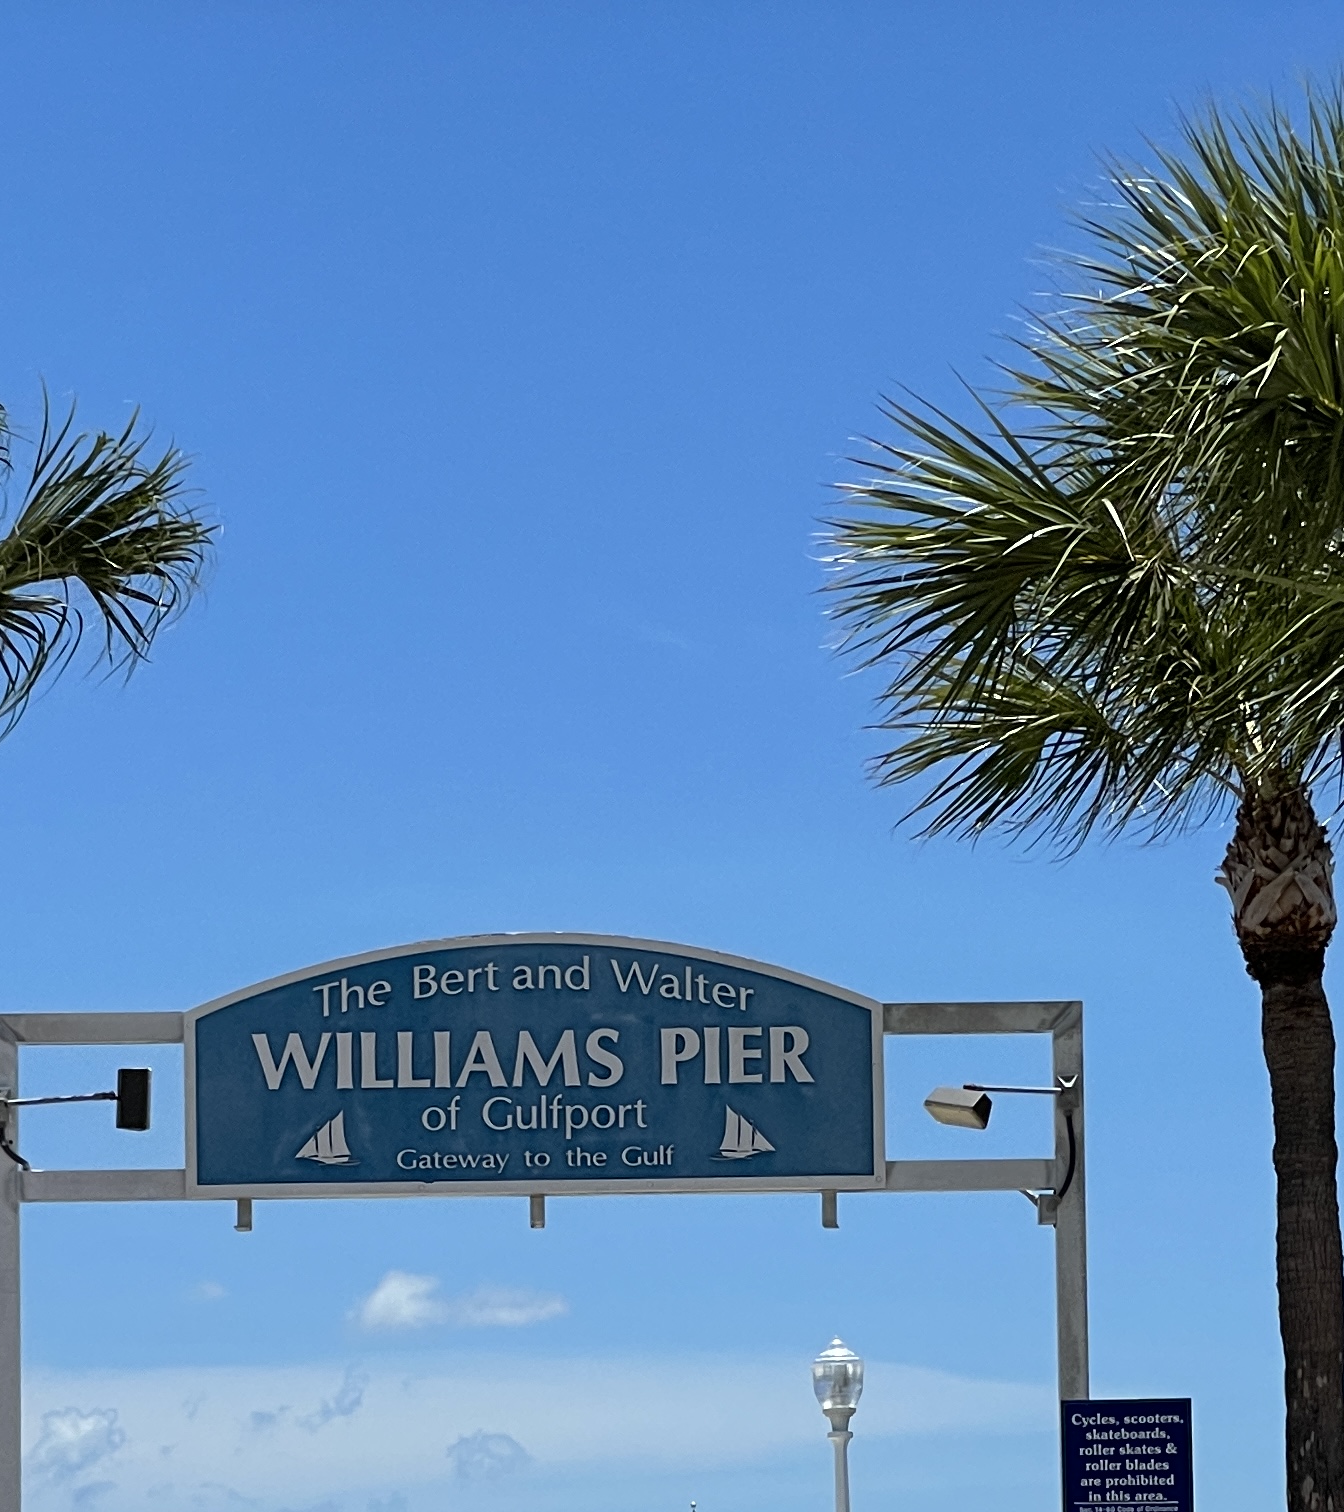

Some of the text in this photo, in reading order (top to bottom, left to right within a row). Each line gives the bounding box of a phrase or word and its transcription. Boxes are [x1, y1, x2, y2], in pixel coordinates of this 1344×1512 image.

[313, 956, 755, 1017] The Bert and Walter
[251, 1026, 814, 1090] WILLIAMS PIER
[421, 1095, 647, 1139] of Gulfport
[396, 1144, 675, 1173] Gateway to the Gulf
[1072, 1413, 1184, 1428] Cycles, scooters,
[1086, 1427, 1170, 1440] skateboards,
[1079, 1442, 1178, 1455] roller skates &
[1086, 1459, 1170, 1471] roller blades
[1080, 1474, 1174, 1488] are prohibited
[1089, 1490, 1167, 1502] in this area.
